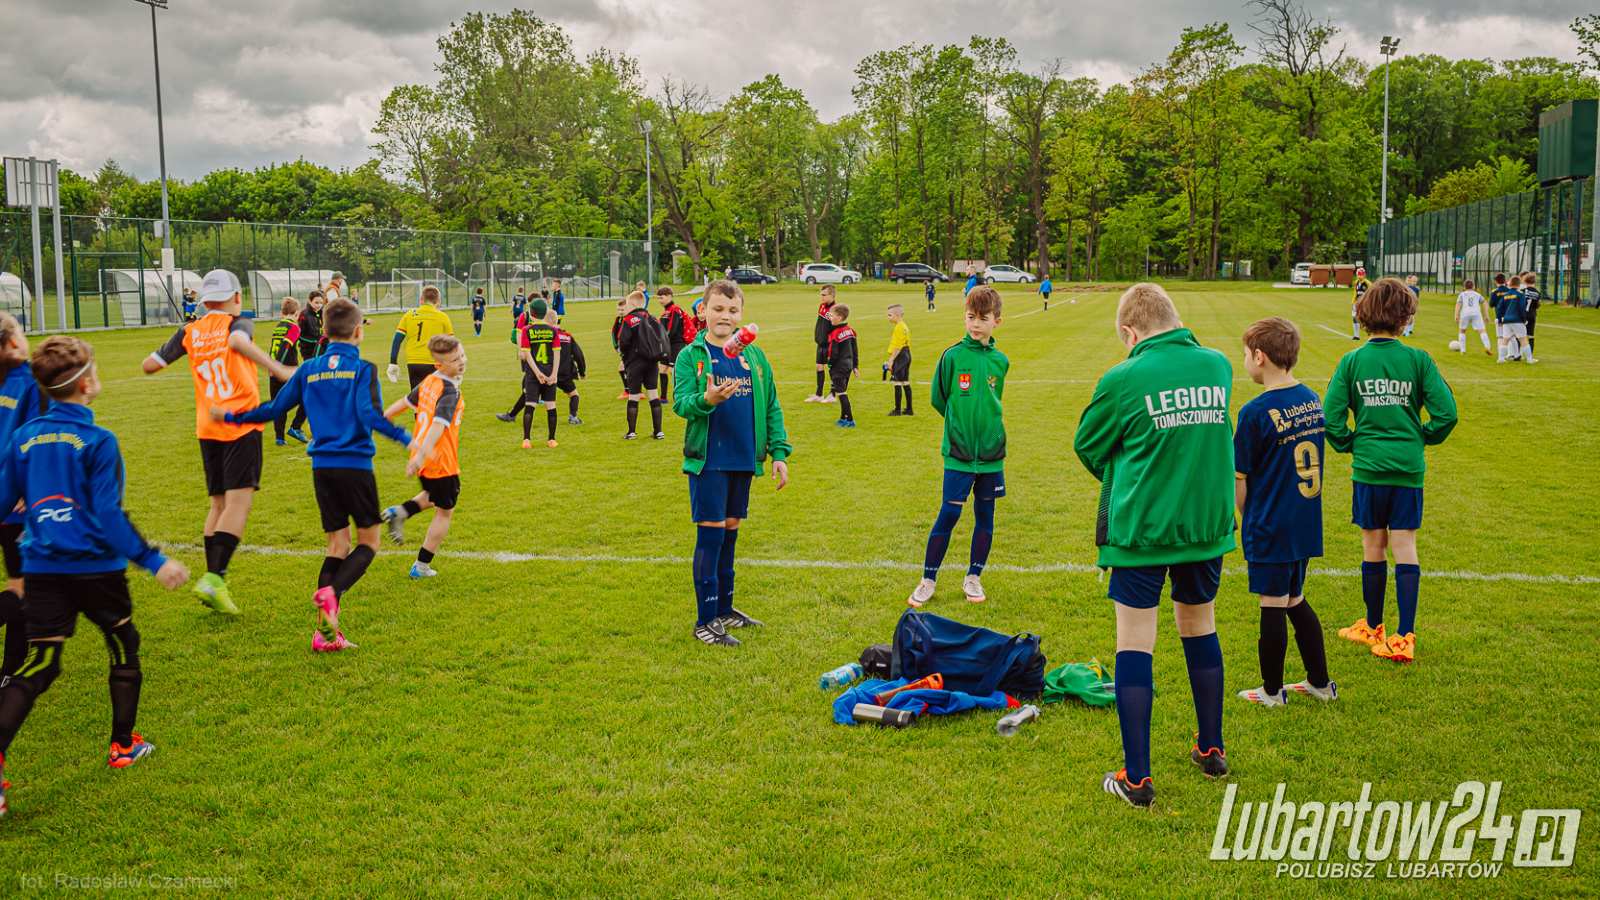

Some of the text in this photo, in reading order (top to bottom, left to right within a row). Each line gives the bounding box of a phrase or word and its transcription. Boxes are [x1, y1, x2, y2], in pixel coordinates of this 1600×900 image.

[416, 321, 423, 342] 1
[536, 343, 548, 364] 4
[1356, 379, 1412, 396] LEGION
[1144, 386, 1226, 416] LEGION
[1152, 409, 1225, 430] TOMASZOWICE
[1294, 440, 1321, 499] 9
